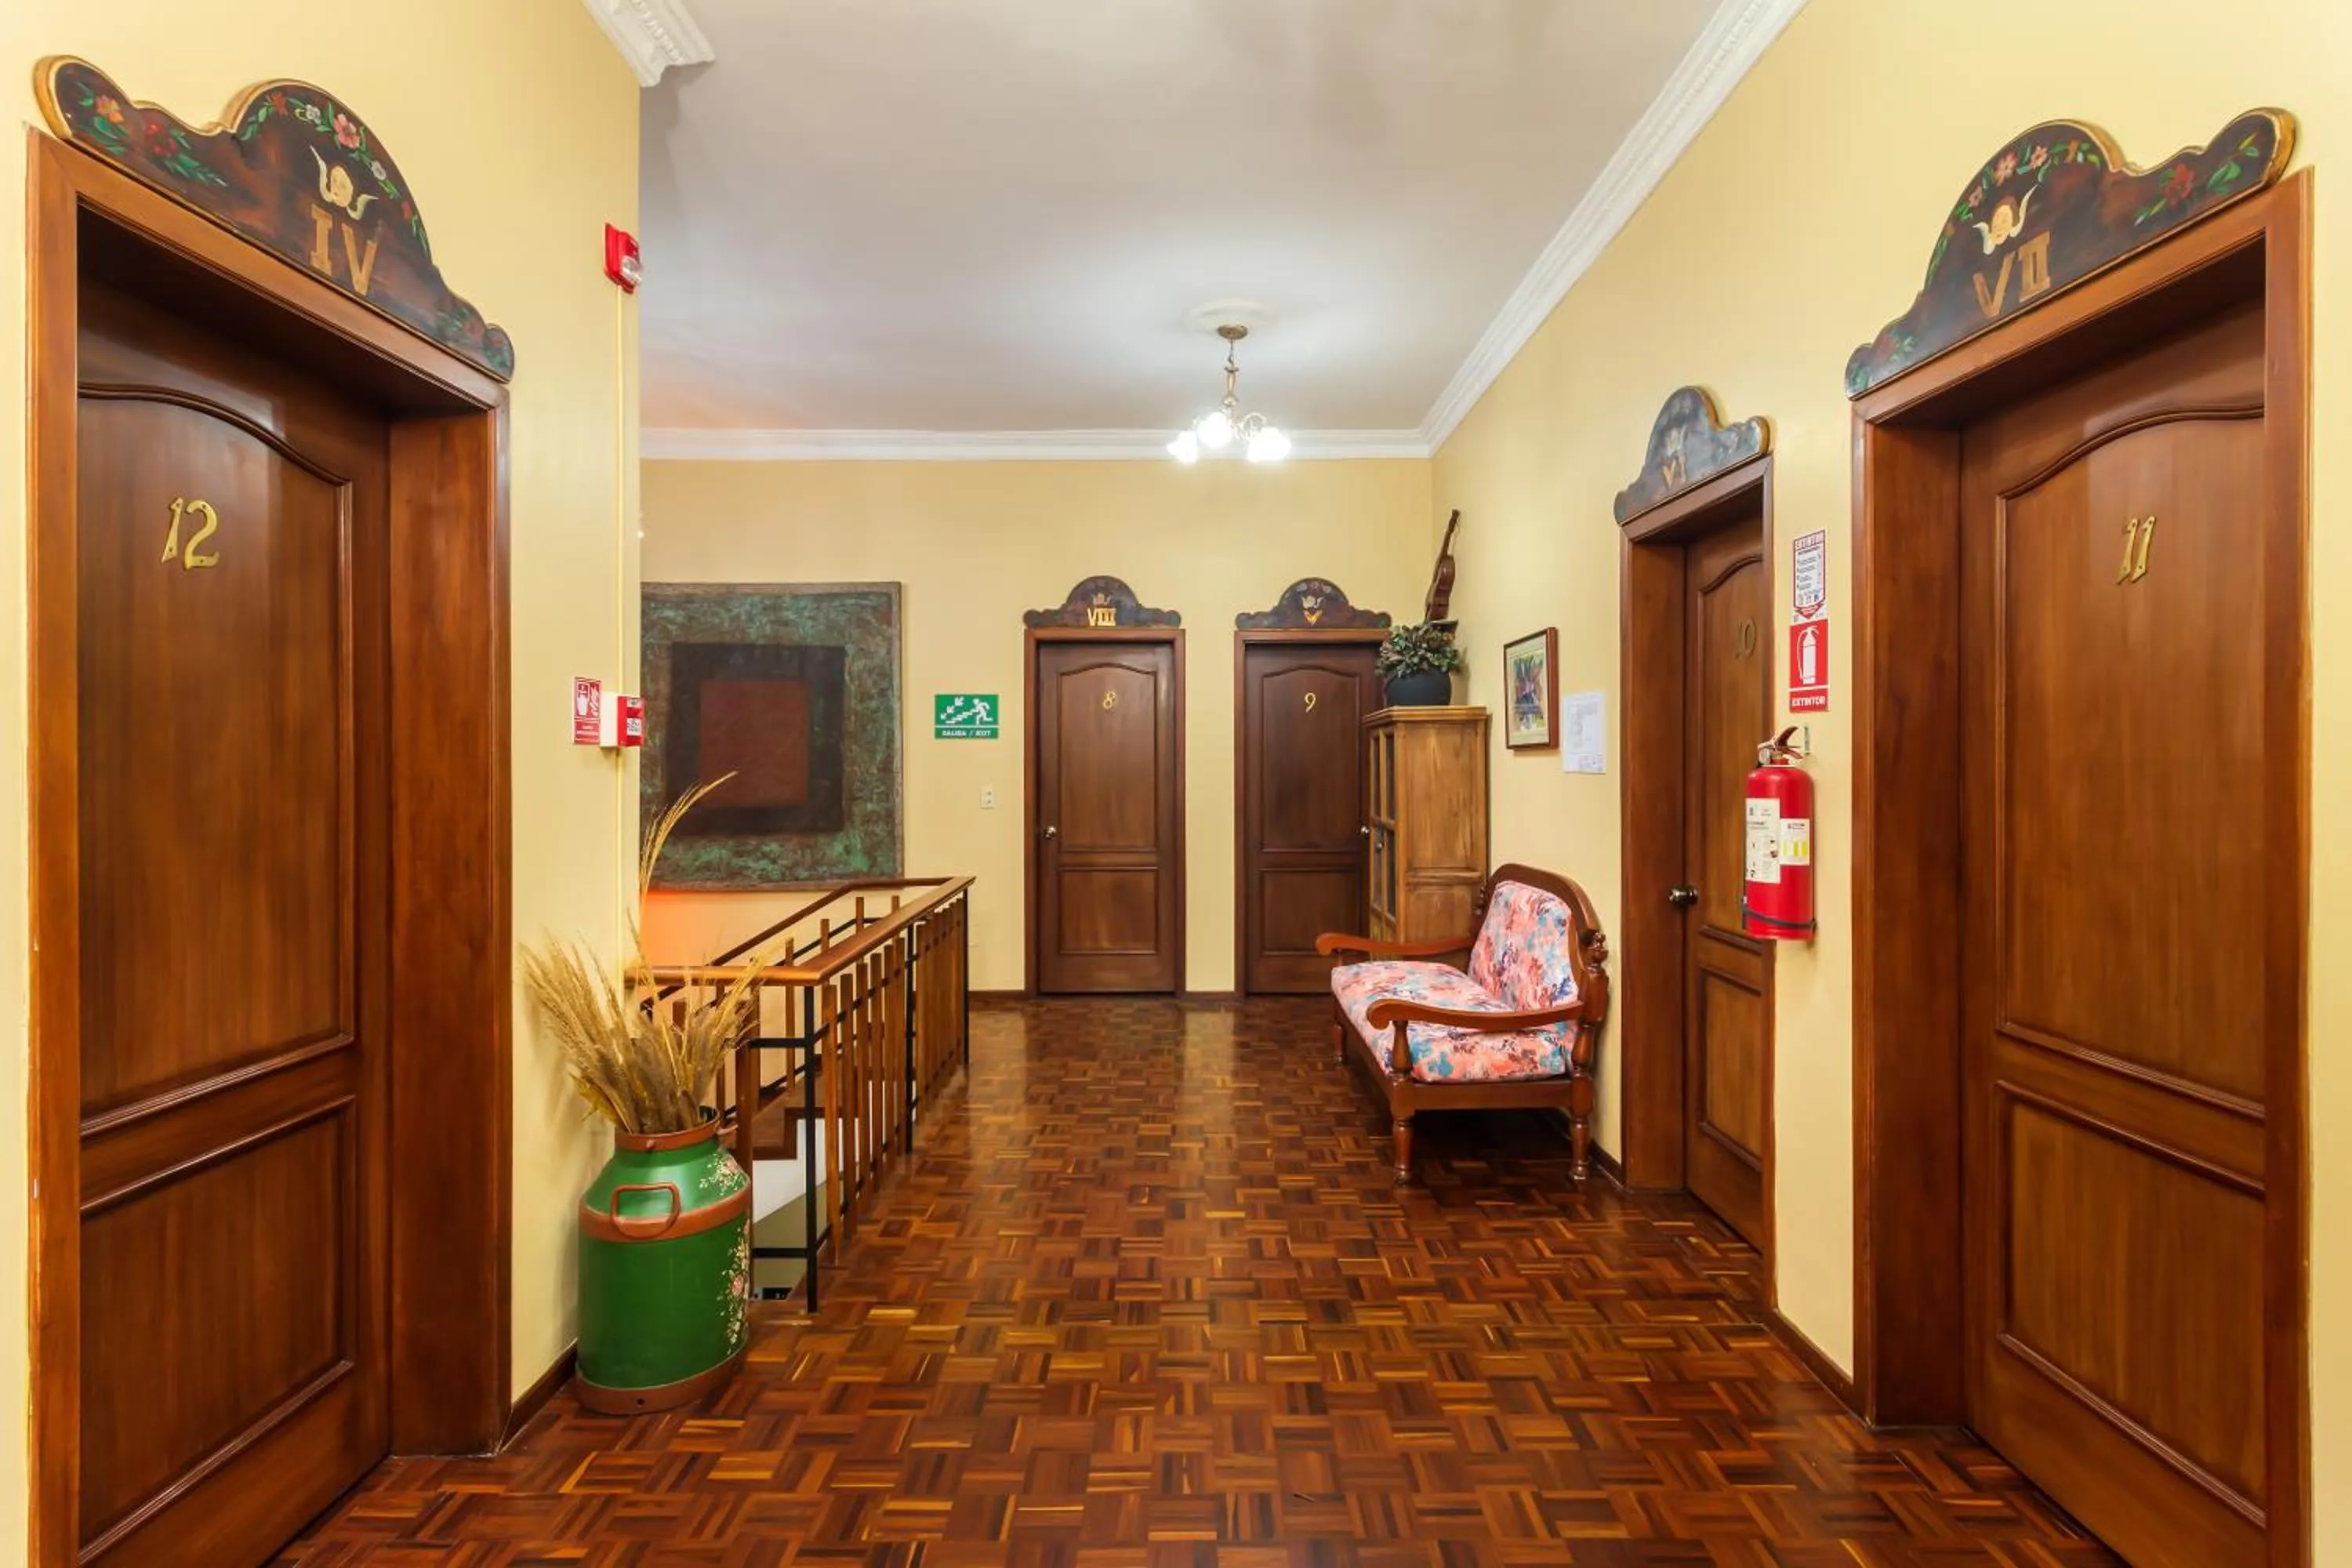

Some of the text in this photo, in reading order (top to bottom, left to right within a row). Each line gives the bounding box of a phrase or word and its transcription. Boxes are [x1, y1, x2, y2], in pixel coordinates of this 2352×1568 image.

[310, 203, 382, 296] IV
[1973, 231, 2051, 319] VII
[161, 496, 220, 570] 12
[2117, 516, 2155, 585] 11
[1087, 608, 1116, 626] VIII
[1303, 609, 1323, 627] V
[1103, 691, 1116, 709] 8
[1305, 692, 1316, 713] 9
